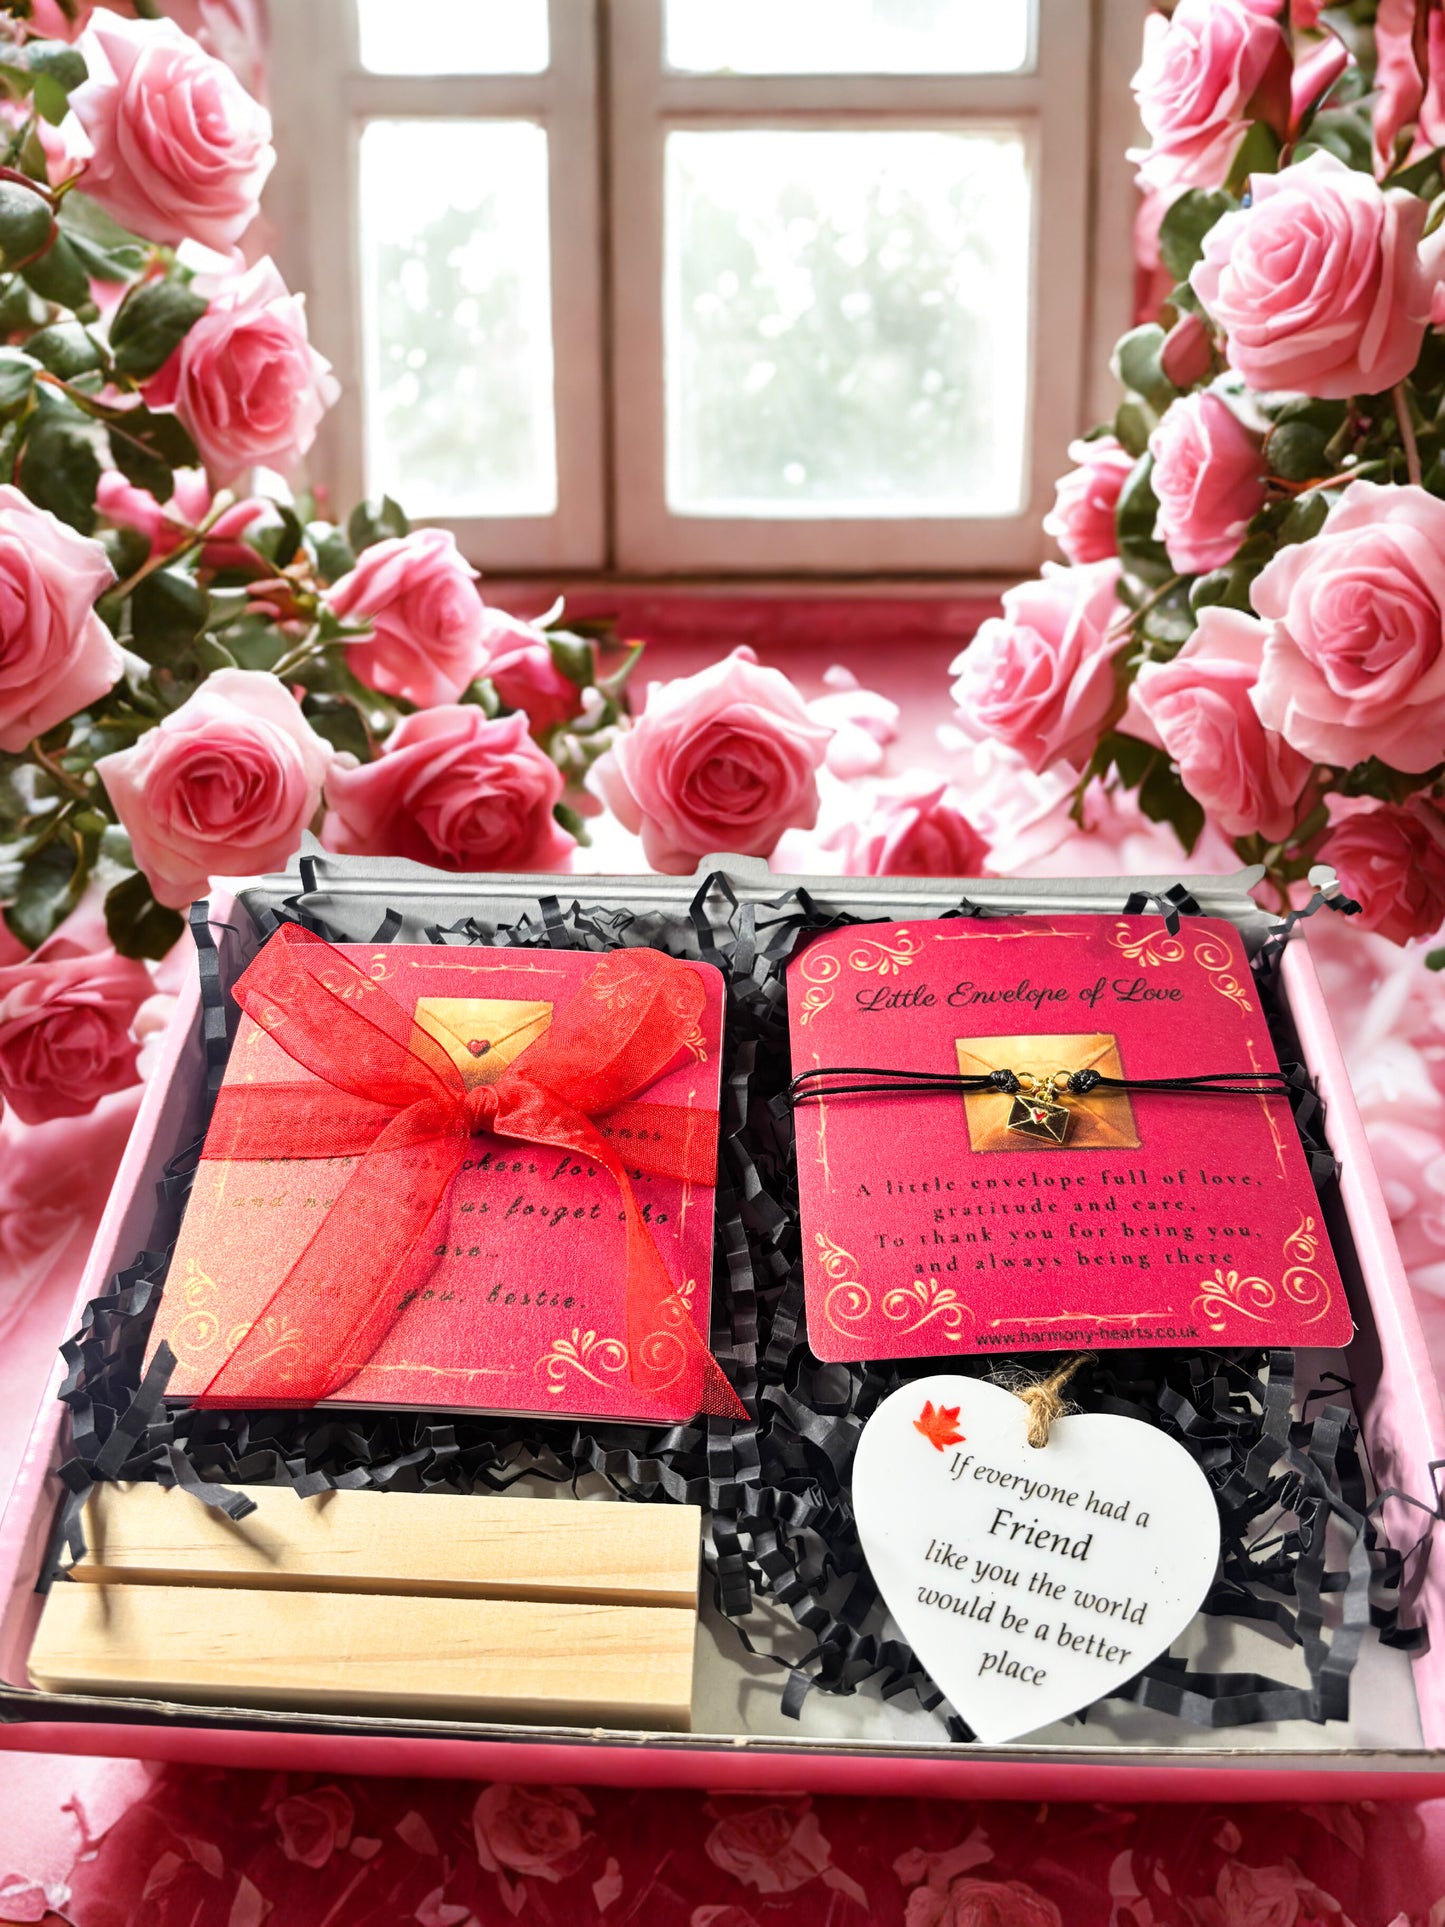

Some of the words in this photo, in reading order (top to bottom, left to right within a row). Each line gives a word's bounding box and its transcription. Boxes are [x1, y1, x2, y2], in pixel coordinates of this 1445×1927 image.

[856, 984, 937, 1012] Little
[947, 979, 1068, 1010] Envelope
[1078, 977, 1107, 1007] of
[1112, 977, 1184, 1003] Love
[461, 1153, 538, 1173] cheer
[552, 1157, 597, 1180] for
[857, 1184, 870, 1197] A
[886, 1177, 955, 1195] little
[971, 1172, 1086, 1191] envelope
[1101, 1169, 1148, 1185] full
[1162, 1170, 1187, 1185] of
[461, 1200, 490, 1214] us
[504, 1196, 601, 1227] forget
[933, 1198, 1058, 1222] gratitude
[1074, 1196, 1117, 1212] and
[876, 1234, 904, 1248] To
[921, 1227, 992, 1245] thank
[1009, 1229, 1053, 1245] you
[1069, 1223, 1106, 1238] for
[1122, 1222, 1195, 1241] being
[914, 1256, 958, 1273] and
[975, 1253, 1062, 1272] always
[1077, 1251, 1150, 1269] being
[1165, 1248, 1233, 1264] there
[975, 1326, 1199, 1345] www.harmony-hearts.co.uk
[949, 1452, 975, 1480] If
[973, 1465, 1079, 1507] everyone
[1085, 1491, 1130, 1522] had
[1135, 1511, 1151, 1528] a
[987, 1507, 1093, 1561] Friend
[925, 1539, 969, 1570] like
[971, 1560, 1018, 1586] you
[1029, 1572, 1066, 1600] the
[1074, 1589, 1148, 1625] world
[917, 1587, 996, 1623] would
[1001, 1605, 1029, 1633] be
[1034, 1623, 1050, 1641] a
[1057, 1623, 1132, 1665] better
[978, 1650, 1047, 1686] place
